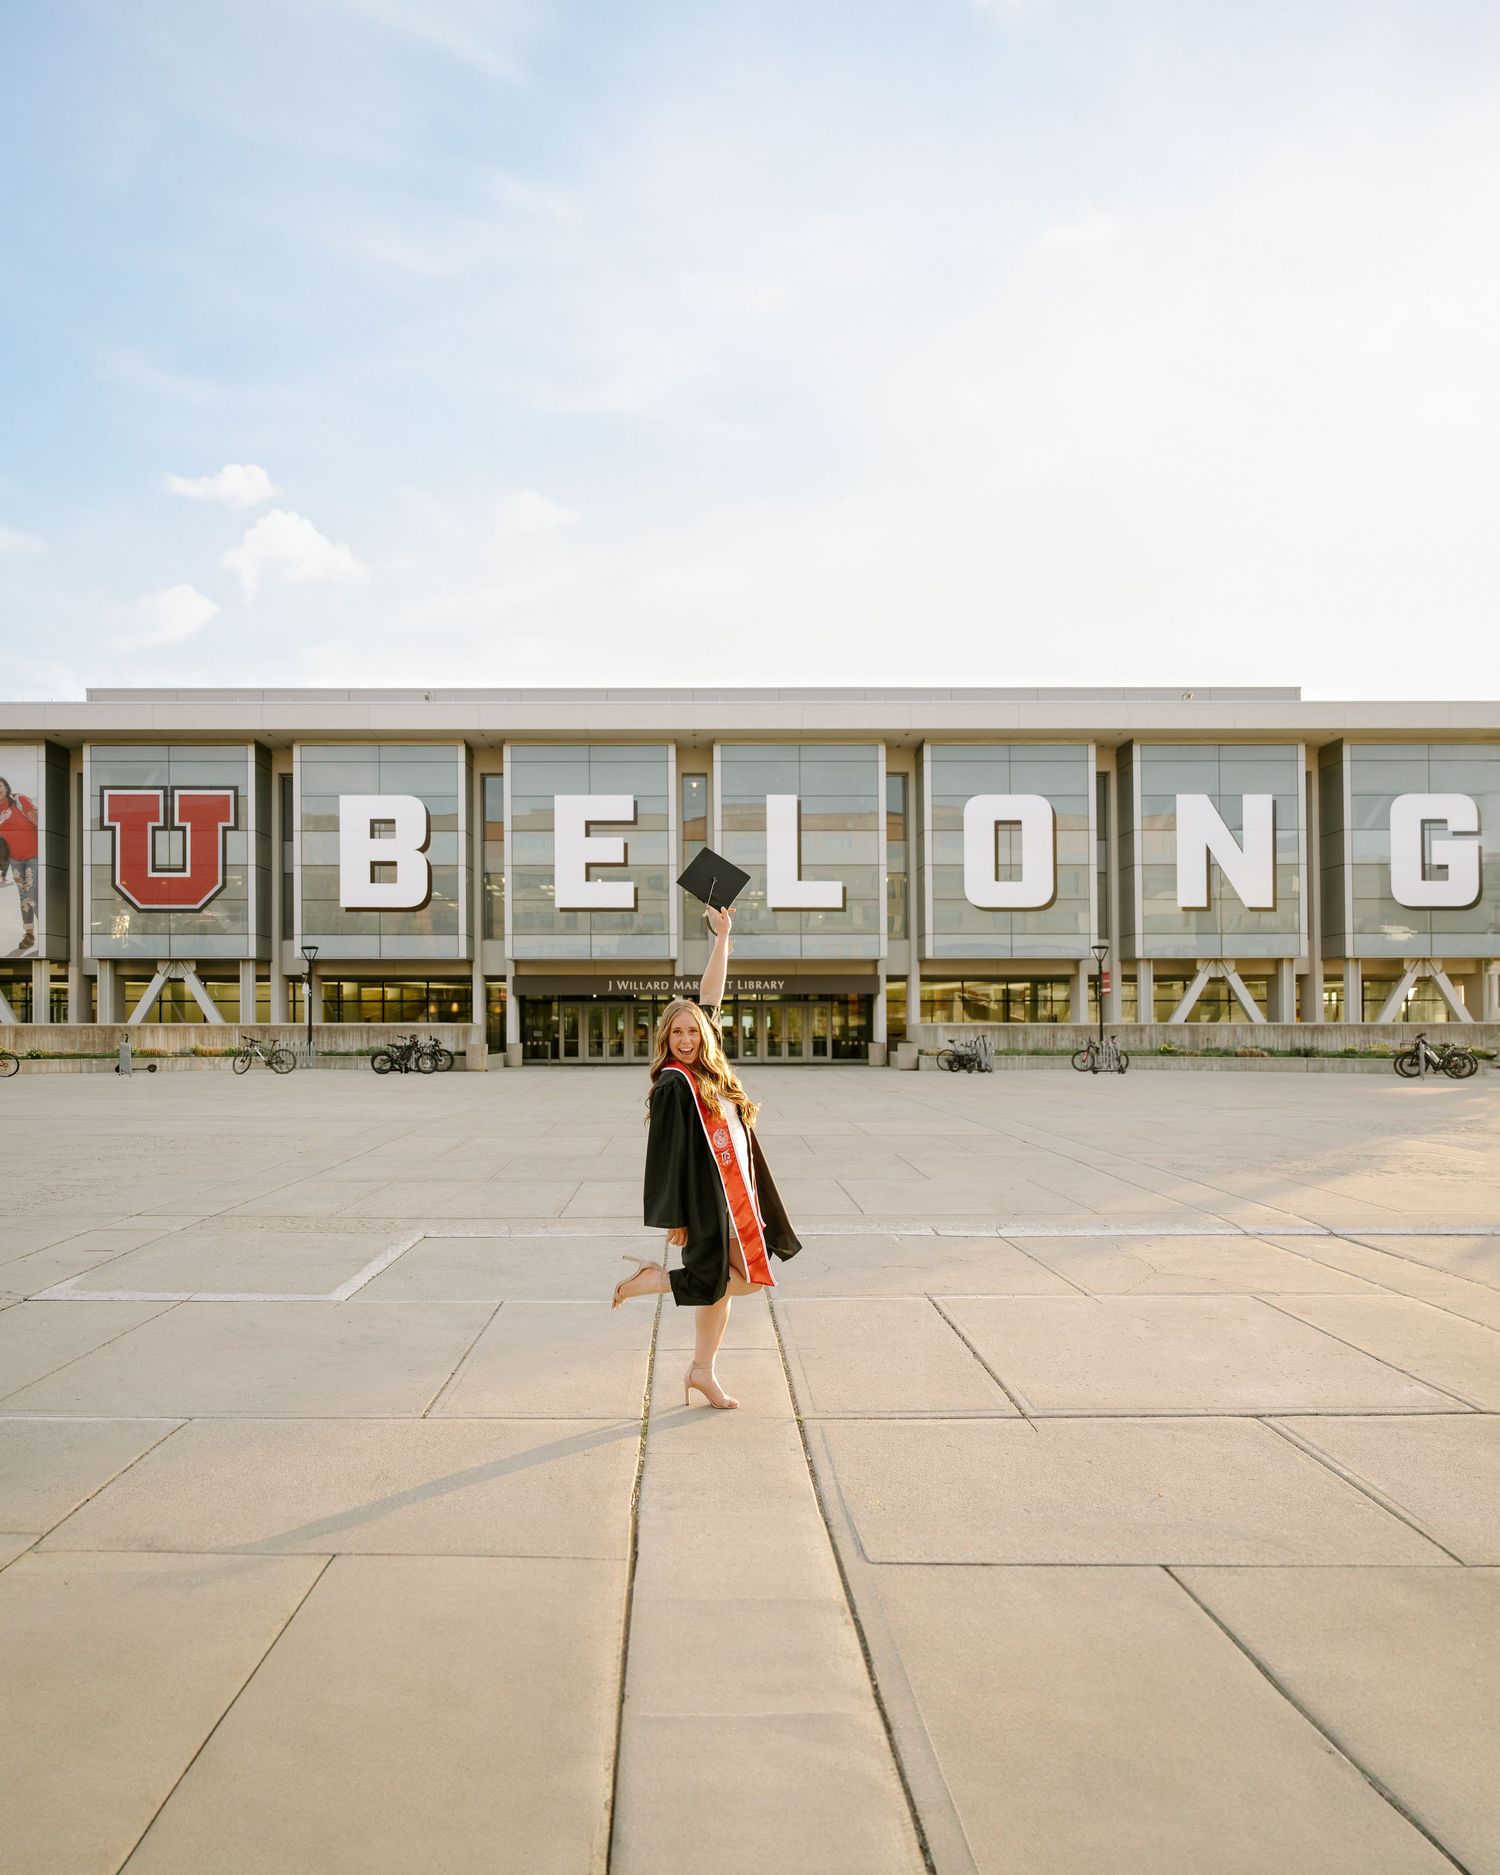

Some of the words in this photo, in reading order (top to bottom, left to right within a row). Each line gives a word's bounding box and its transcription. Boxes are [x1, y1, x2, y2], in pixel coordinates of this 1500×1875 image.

[100, 785, 239, 912] U
[608, 980, 613, 991] J
[617, 980, 669, 990] WILLARD
[673, 980, 734, 990] MART
[738, 980, 785, 990] LIBRARY
